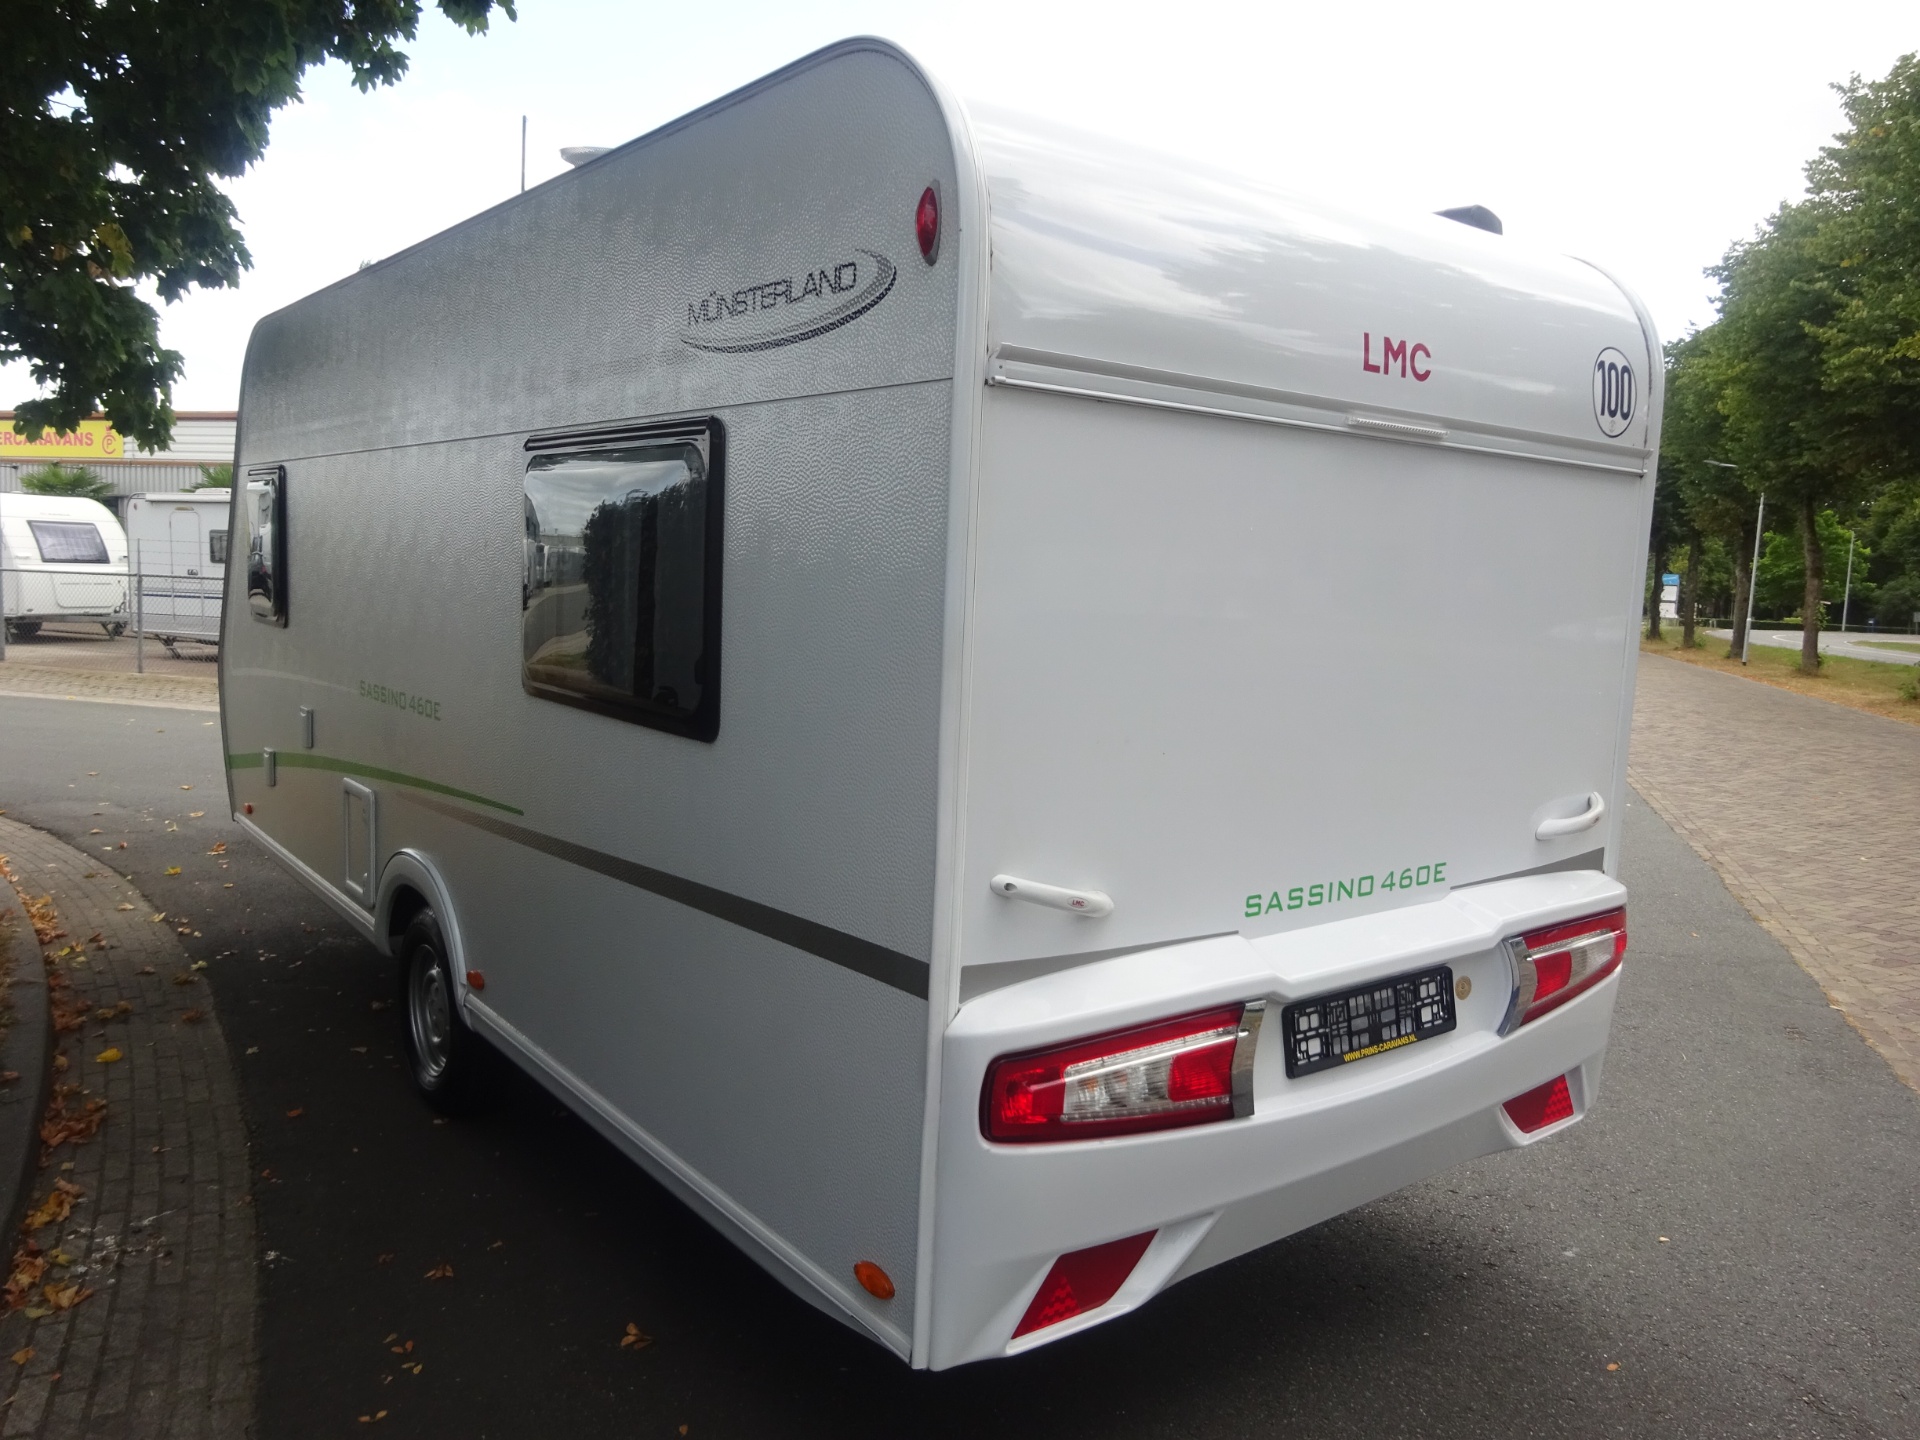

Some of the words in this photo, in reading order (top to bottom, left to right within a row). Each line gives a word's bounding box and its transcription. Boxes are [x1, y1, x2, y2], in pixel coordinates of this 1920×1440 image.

[1362, 331, 1432, 383] LMC
[1597, 359, 1632, 421] 100
[360, 679, 407, 711] SASSINO
[408, 695, 442, 721] 460E
[1071, 899, 1085, 907] LMC
[1244, 874, 1375, 918] SASSINO
[1380, 861, 1448, 891] 460E
[1343, 1033, 1418, 1063] WWW.PRINS-CARAVANS.NL
